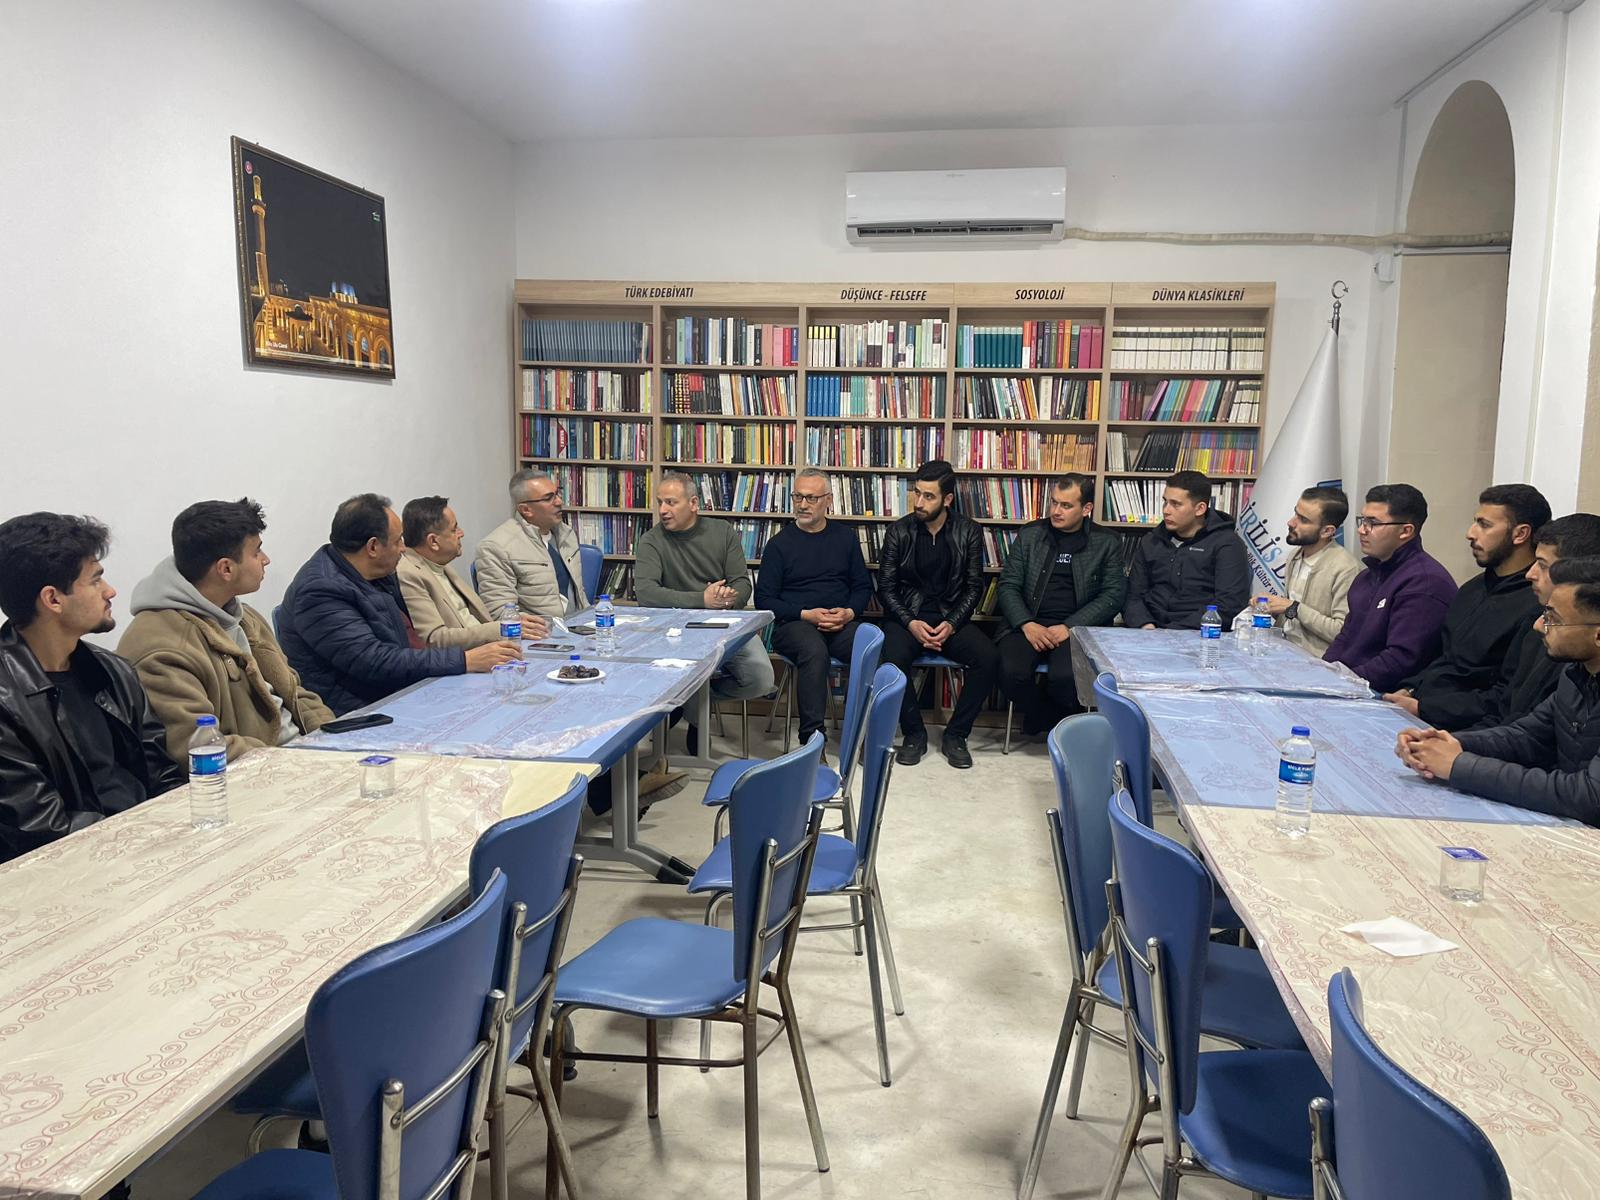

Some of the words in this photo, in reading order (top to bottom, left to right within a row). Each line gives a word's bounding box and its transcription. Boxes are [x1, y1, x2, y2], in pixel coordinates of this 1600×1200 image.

[625, 285, 648, 298] TÜRK
[649, 285, 694, 298] EDEBİYATI
[840, 287, 883, 303] DÜŞÜNCE
[890, 290, 927, 301] FELSEFE
[1014, 286, 1066, 300] SOSYOLOJİ
[1152, 287, 1186, 301] DÜNYA
[1187, 287, 1246, 301] KLASİKLERİ
[1253, 564, 1272, 588] Kültür
